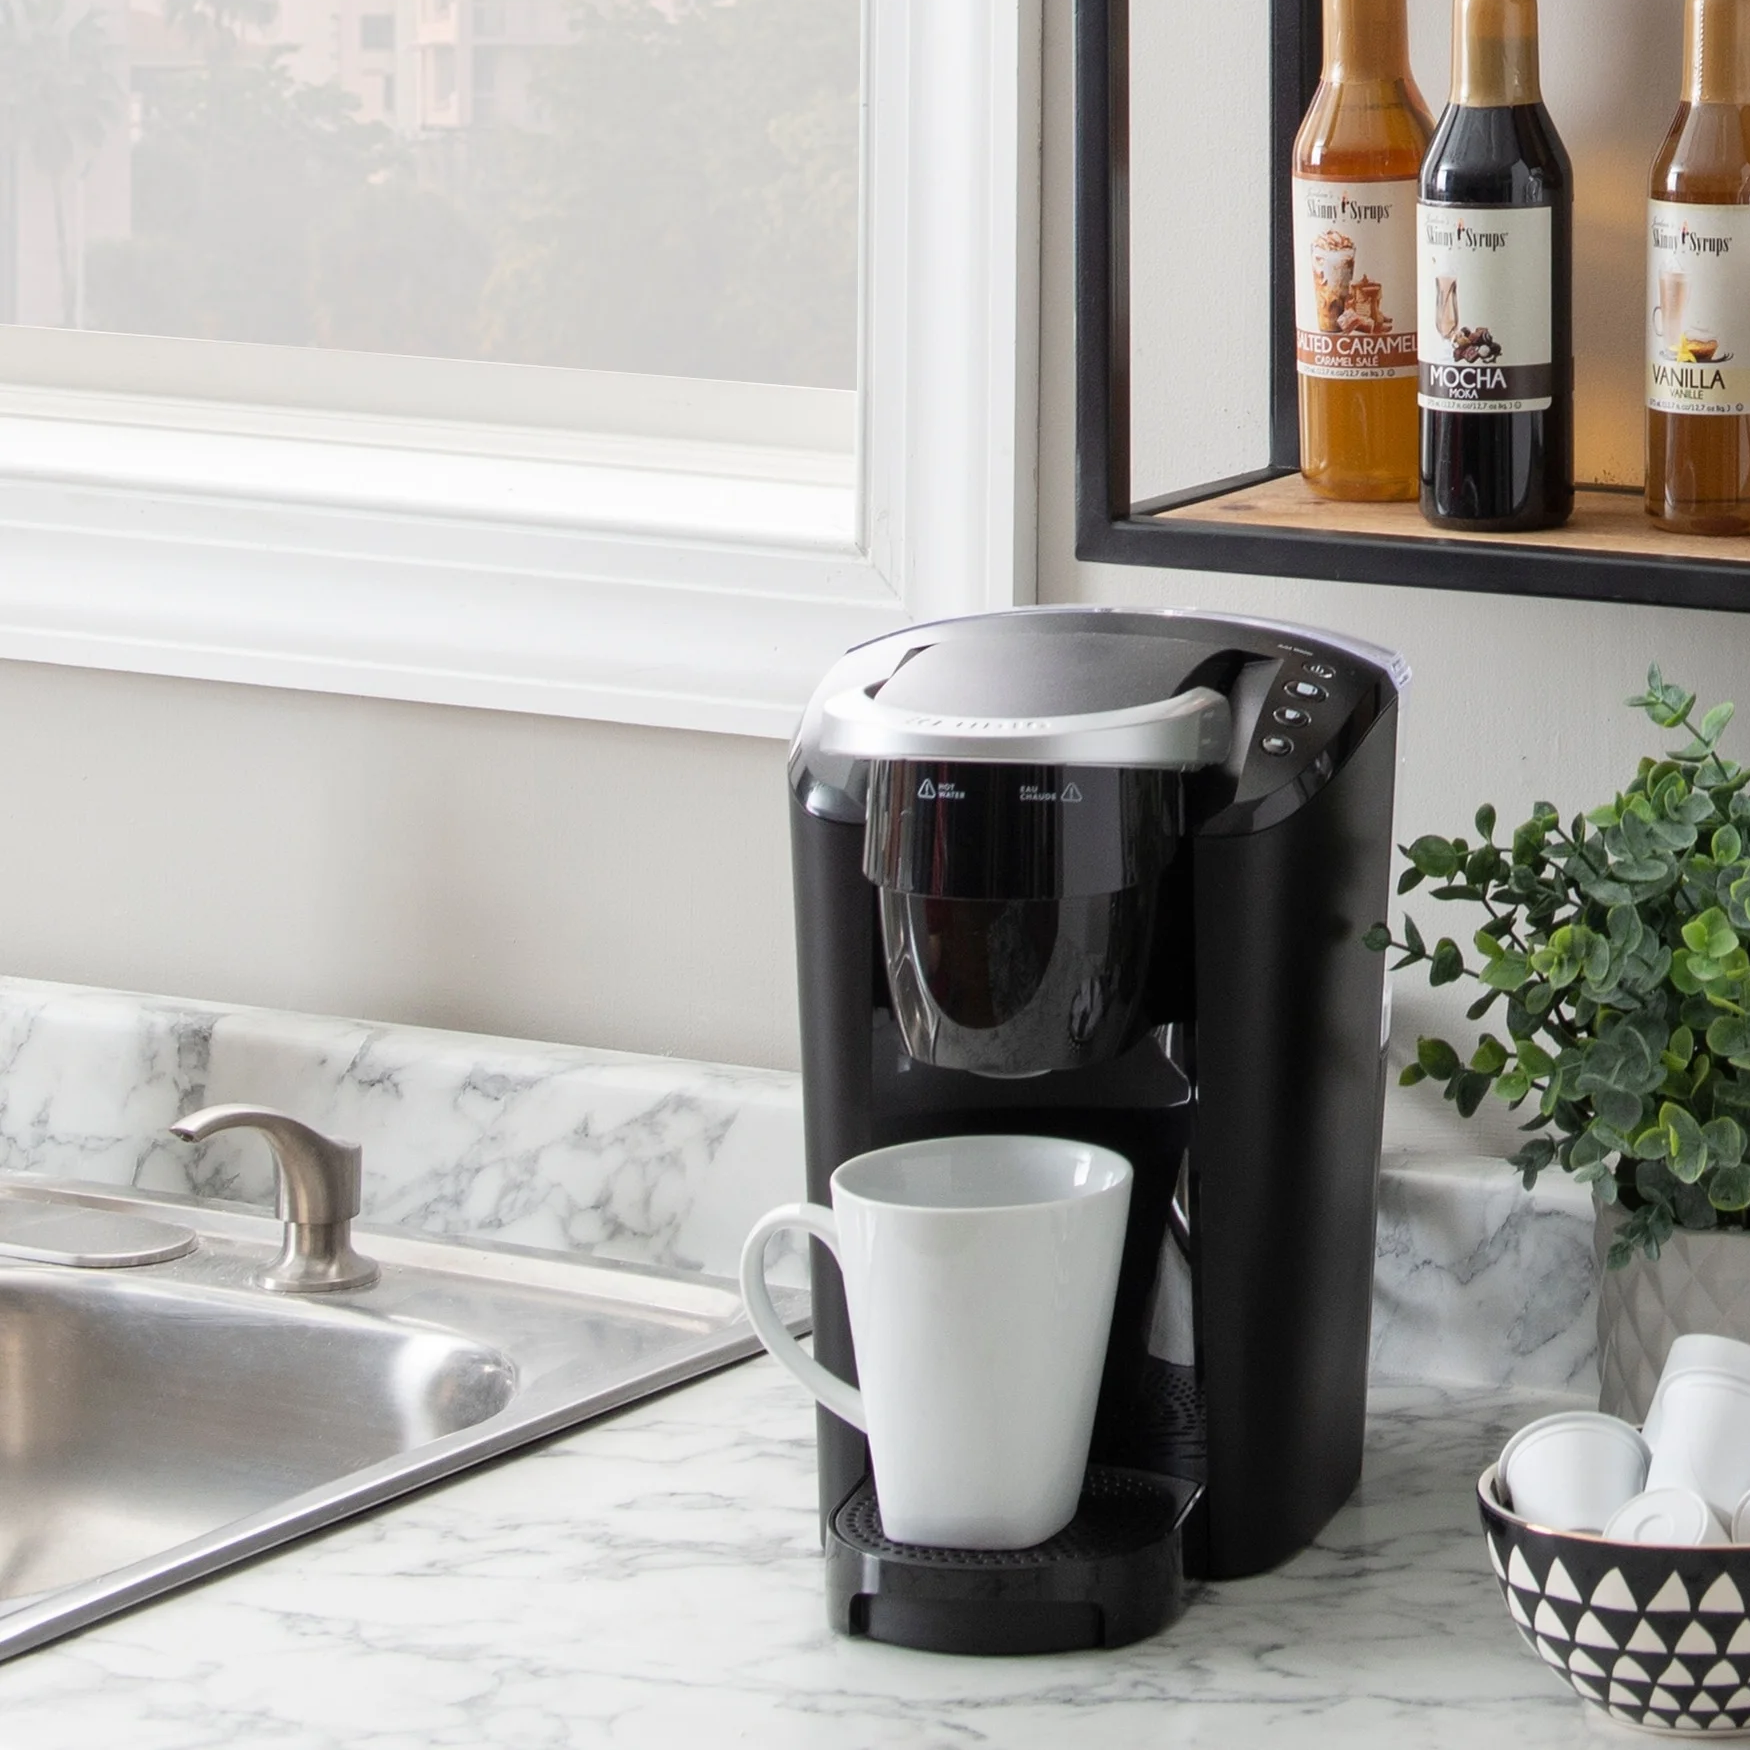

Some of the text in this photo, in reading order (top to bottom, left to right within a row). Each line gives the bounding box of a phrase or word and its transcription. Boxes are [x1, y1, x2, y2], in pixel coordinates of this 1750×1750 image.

[1307, 199, 1390, 223] Skinny Syrups
[1427, 225, 1506, 252] Skinny Syrups
[1653, 228, 1729, 257] Skinny Syrups
[1297, 332, 1417, 355] ALTED CARAMEL
[1315, 355, 1379, 367] CARAMEL SALÉ
[1430, 365, 1507, 389] MOCHA
[1653, 363, 1726, 389] VANILLA
[1449, 388, 1478, 399] MOKA
[1670, 388, 1704, 400] VANILLE
[1020, 785, 1038, 793] EAU
[1020, 793, 1057, 801] CHAUDE
